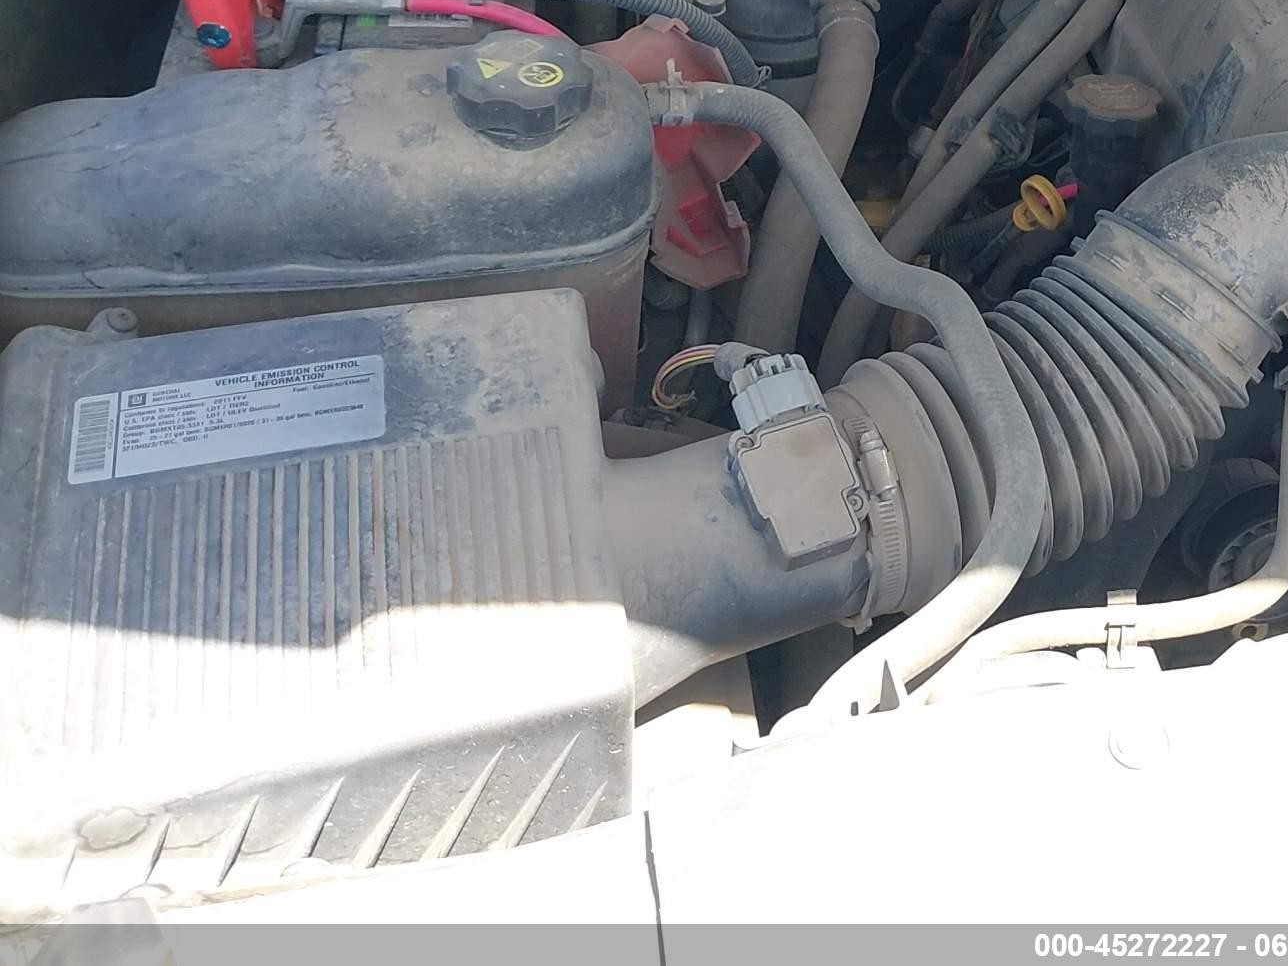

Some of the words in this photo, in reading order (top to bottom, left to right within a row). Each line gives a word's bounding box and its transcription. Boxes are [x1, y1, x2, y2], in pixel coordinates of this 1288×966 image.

[215, 375, 257, 387] VEHICLE
[261, 367, 311, 380] EMISSION
[313, 360, 360, 372] CONTROL
[254, 372, 325, 388] INFORMATION
